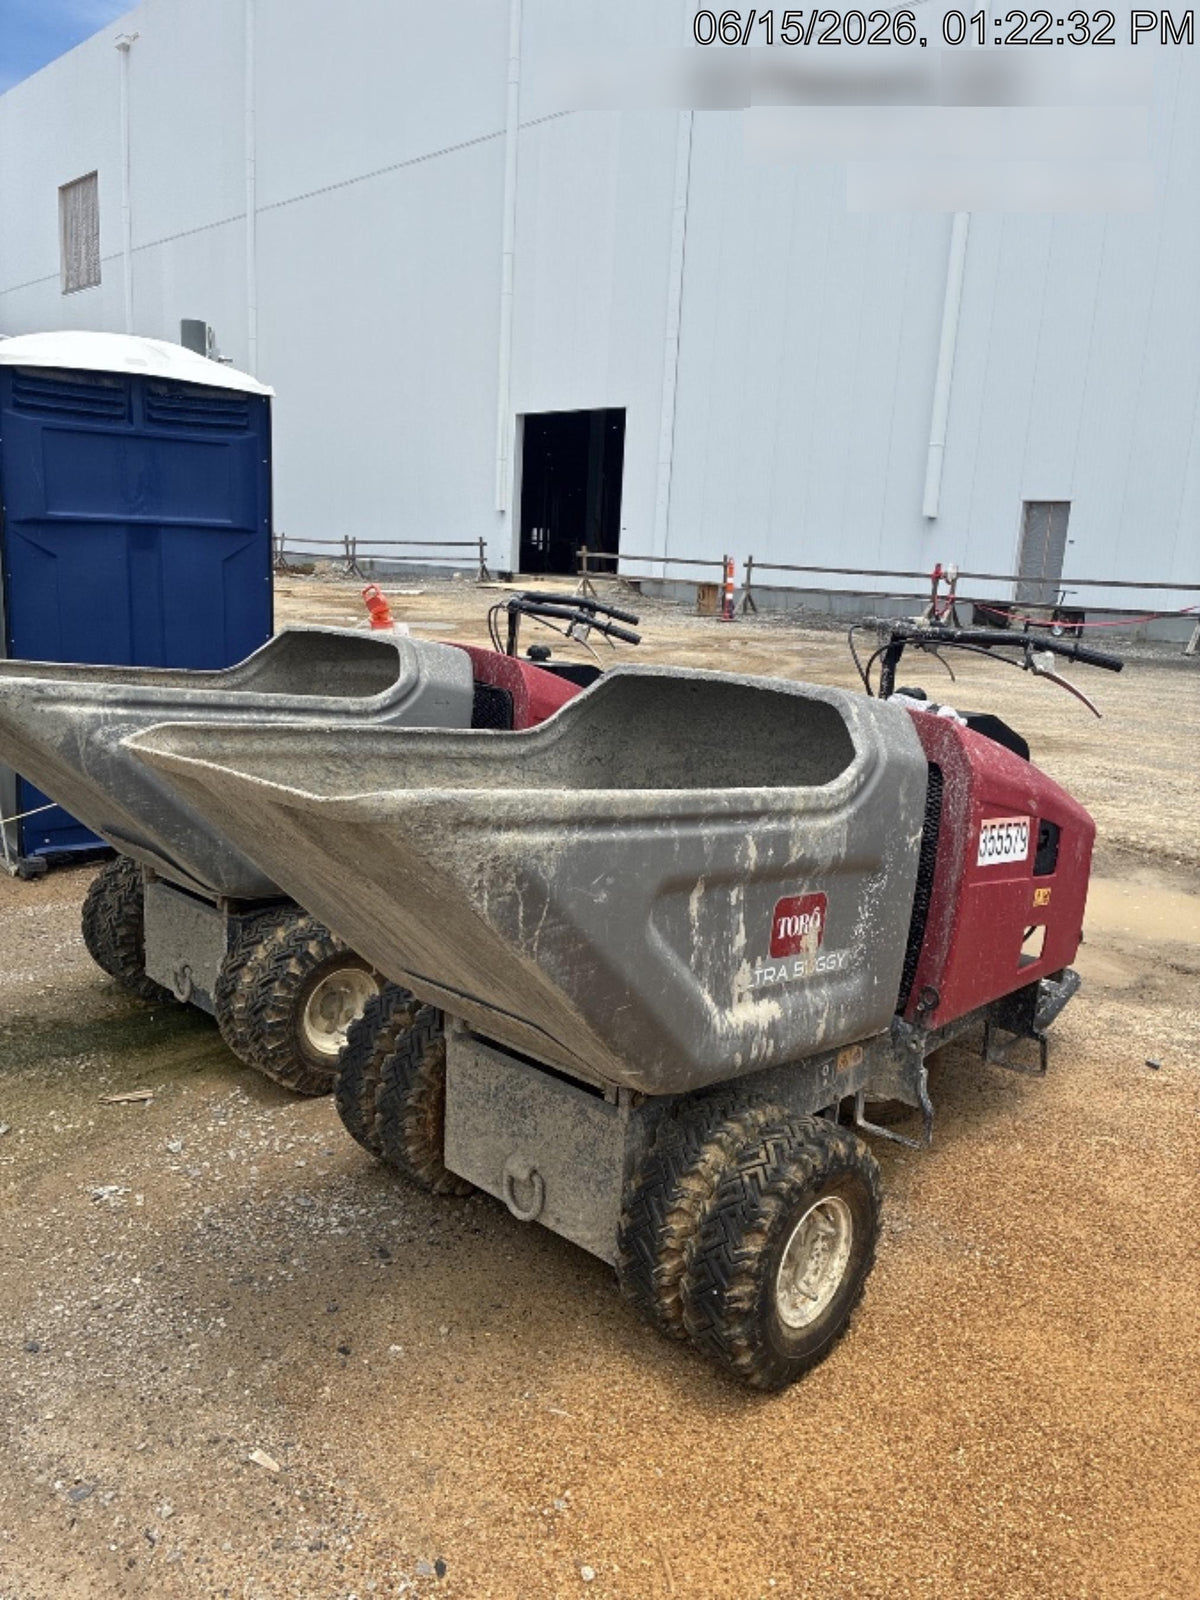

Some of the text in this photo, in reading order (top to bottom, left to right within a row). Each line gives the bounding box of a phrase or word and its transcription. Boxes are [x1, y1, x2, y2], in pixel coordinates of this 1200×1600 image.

[979, 821, 1028, 858] 355579
[739, 952, 846, 988] TRA BGGY
